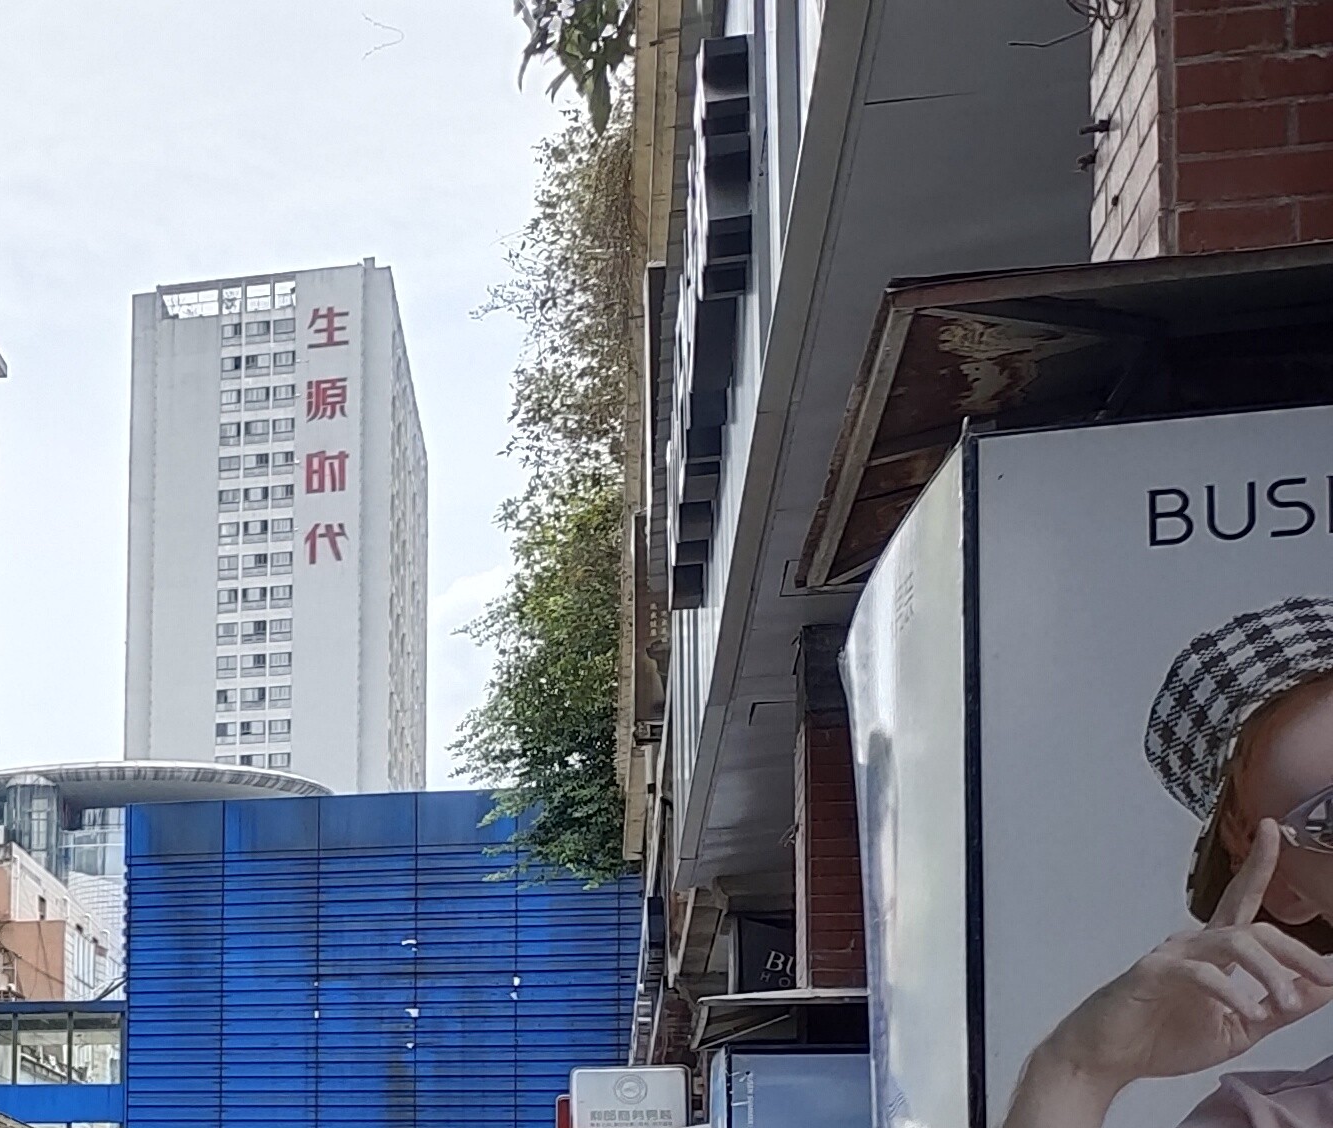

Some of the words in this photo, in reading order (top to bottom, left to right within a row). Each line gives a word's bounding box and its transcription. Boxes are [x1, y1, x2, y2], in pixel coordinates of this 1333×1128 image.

[305, 307, 349, 565] 生源时代
[1146, 475, 1333, 546] BUS
